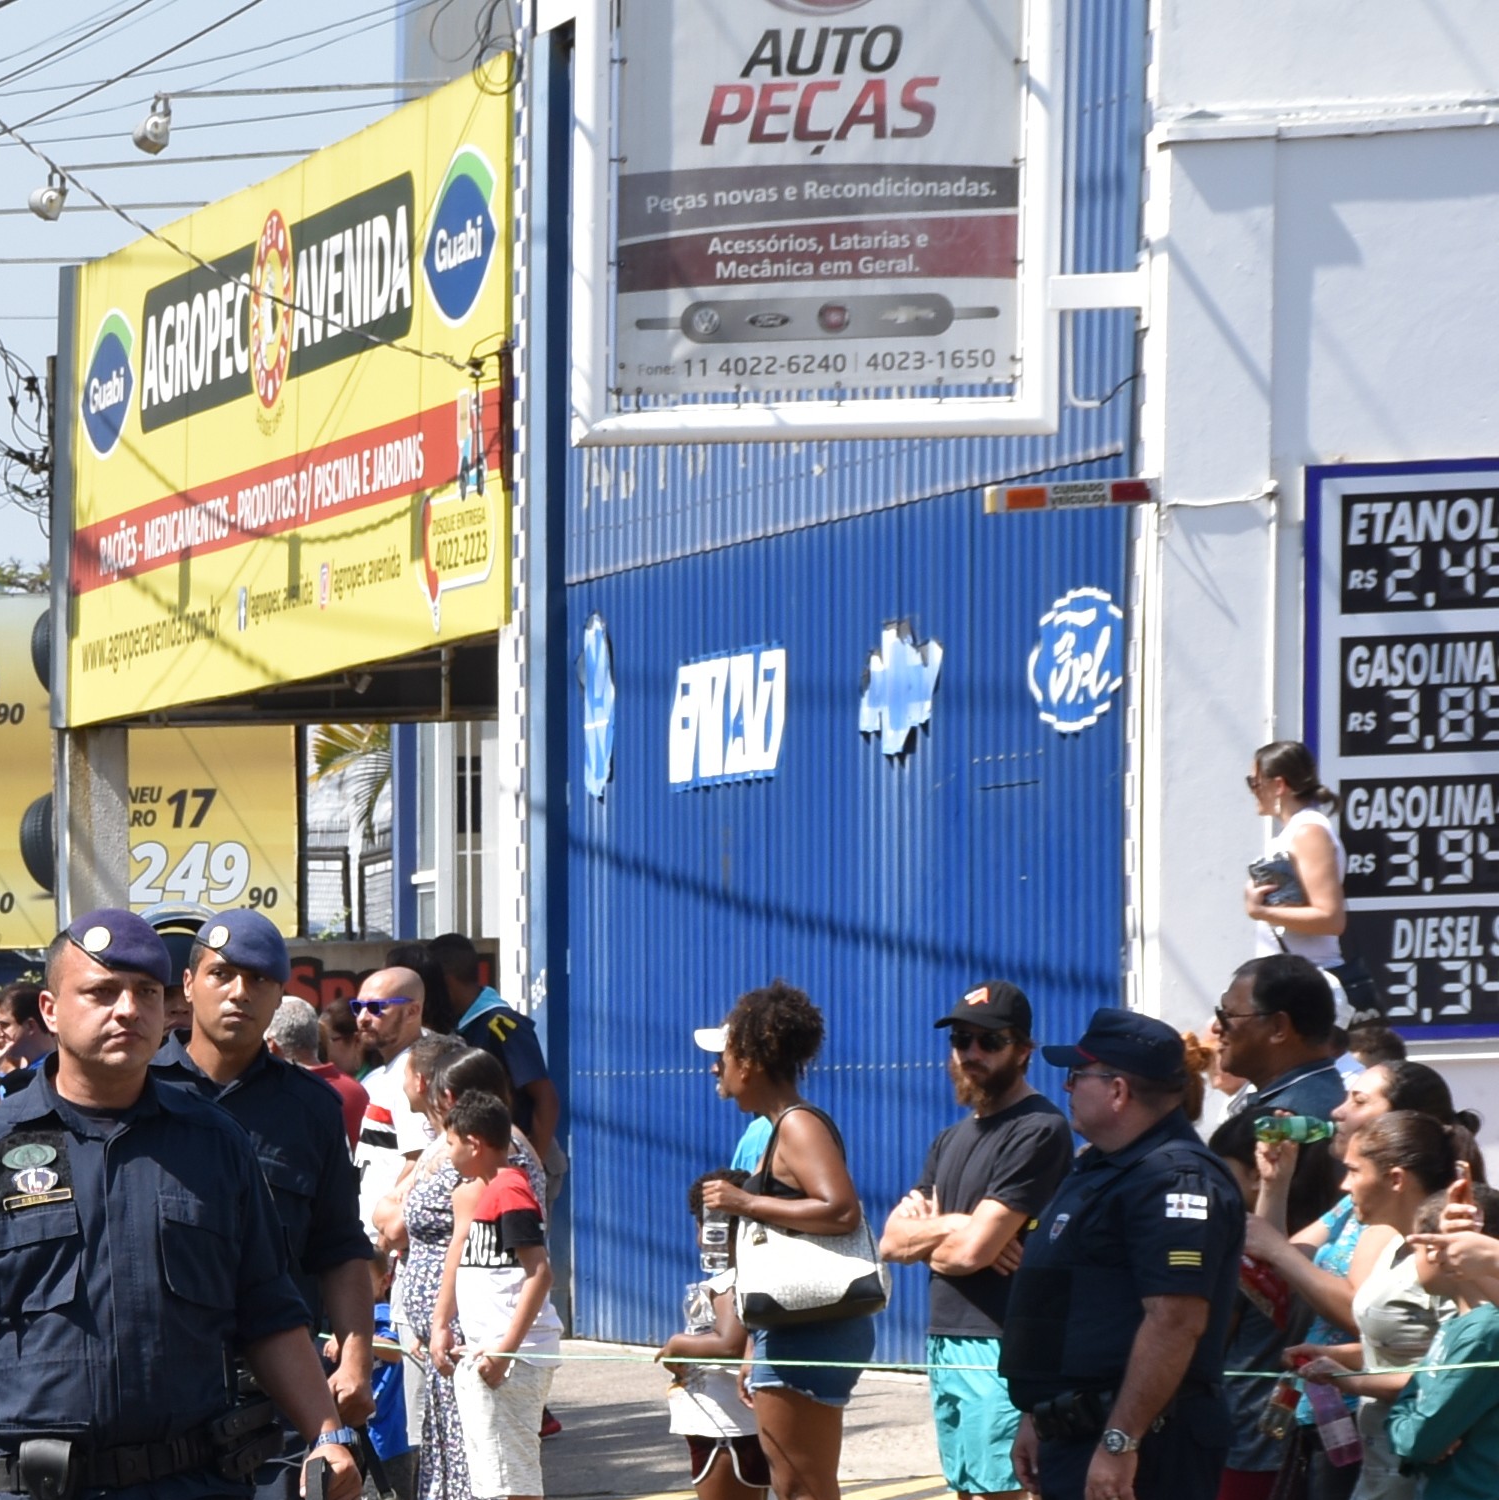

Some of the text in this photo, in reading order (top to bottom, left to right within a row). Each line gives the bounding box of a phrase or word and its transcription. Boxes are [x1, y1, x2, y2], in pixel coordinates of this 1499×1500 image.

[740, 25, 902, 78] AUTO
[700, 76, 940, 155] PEÇAS
[646, 176, 997, 216] Peças novas e Recondicionadas.
[434, 216, 483, 274] Guabi
[708, 231, 928, 256] Acessórios, Latarias e
[716, 254, 919, 280] Mecânica em Geral.
[292, 204, 412, 352] AVENIDA
[142, 272, 251, 411] AGROPEC
[638, 348, 995, 377] Fone: 11 4022-6240 4023-1650
[89, 366, 125, 413] Guabi
[99, 520, 138, 581] RAÇÕES
[143, 493, 229, 562] MEDICAMENTOS
[237, 478, 297, 532] PRODUTOS
[314, 455, 361, 510] PISCINA
[362, 457, 370, 491] E
[372, 433, 424, 491] JARDINS
[432, 506, 486, 537] DISQUE ENTREGA
[1348, 497, 1499, 546] ETANOL
[368, 544, 401, 585] avenida
[435, 529, 489, 572] 4022-2223
[1348, 569, 1378, 591] R$
[81, 595, 222, 674] www.agropecavenida.com.br
[1347, 640, 1496, 691] GASOLINA
[1347, 711, 1377, 734] R$
[128, 786, 217, 829] NEU 17
[130, 809, 156, 828] RO
[1346, 782, 1495, 831] GASOLINA
[129, 840, 251, 905] 249
[1347, 853, 1376, 875] R$
[1392, 915, 1483, 962] DIESEL
